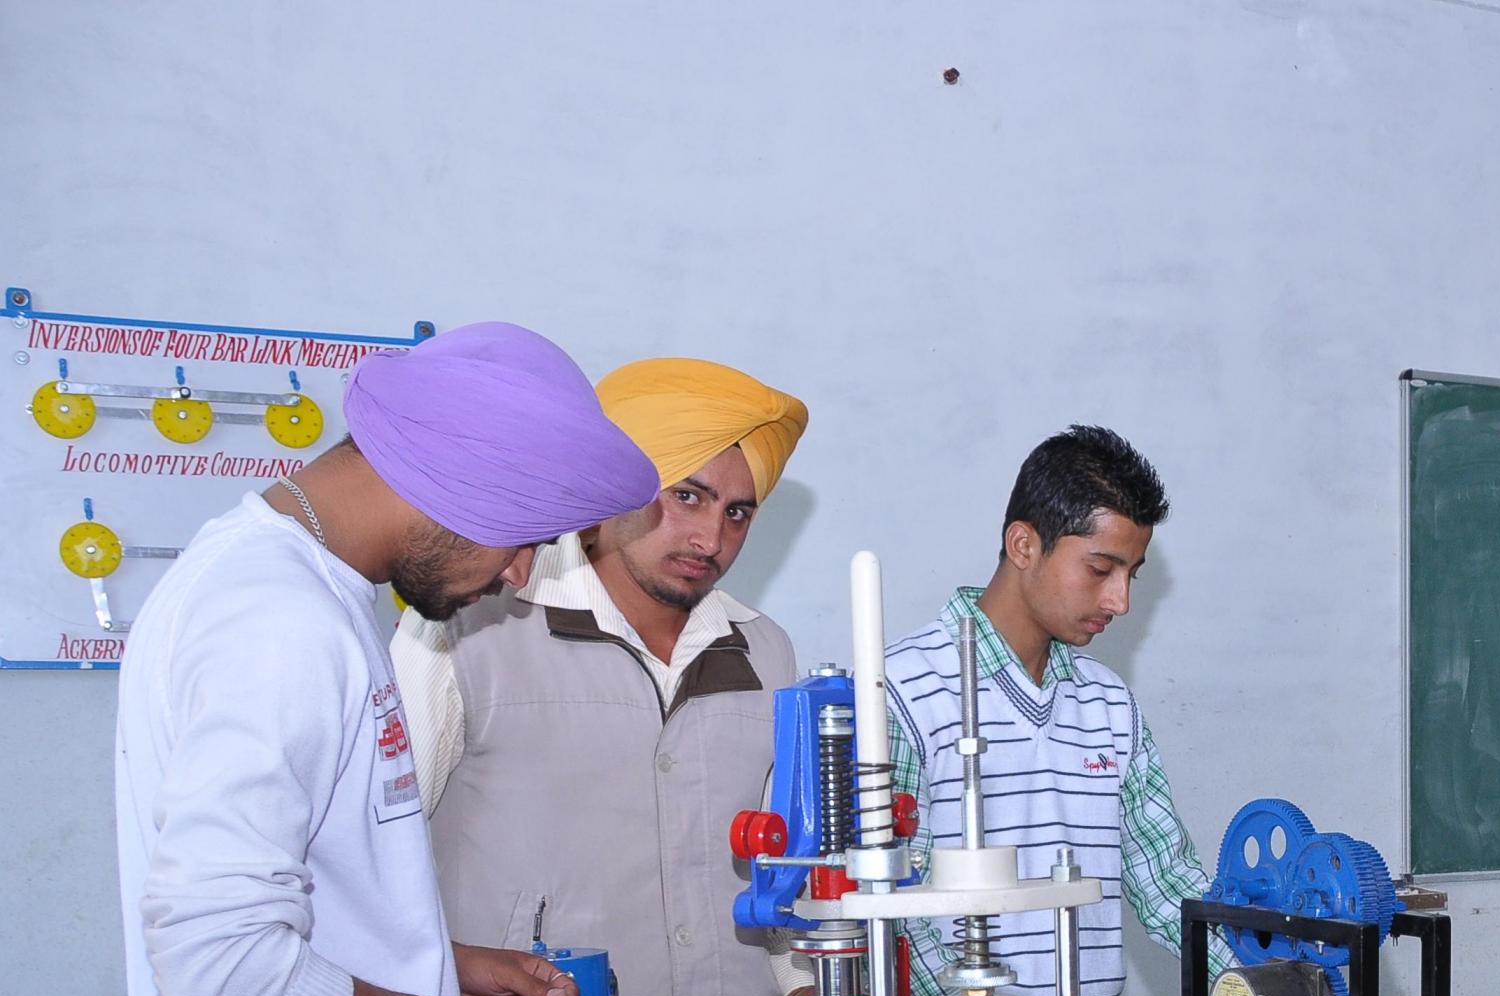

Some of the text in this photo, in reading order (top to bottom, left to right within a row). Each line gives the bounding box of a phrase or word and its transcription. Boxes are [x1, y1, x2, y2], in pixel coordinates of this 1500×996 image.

[28, 320, 144, 356] INVERSIONS
[142, 331, 164, 355] OF
[163, 330, 214, 360] FOUR
[215, 334, 248, 363] BAR
[250, 335, 298, 366] LINK
[62, 445, 208, 477] LOCOMOTIVE
